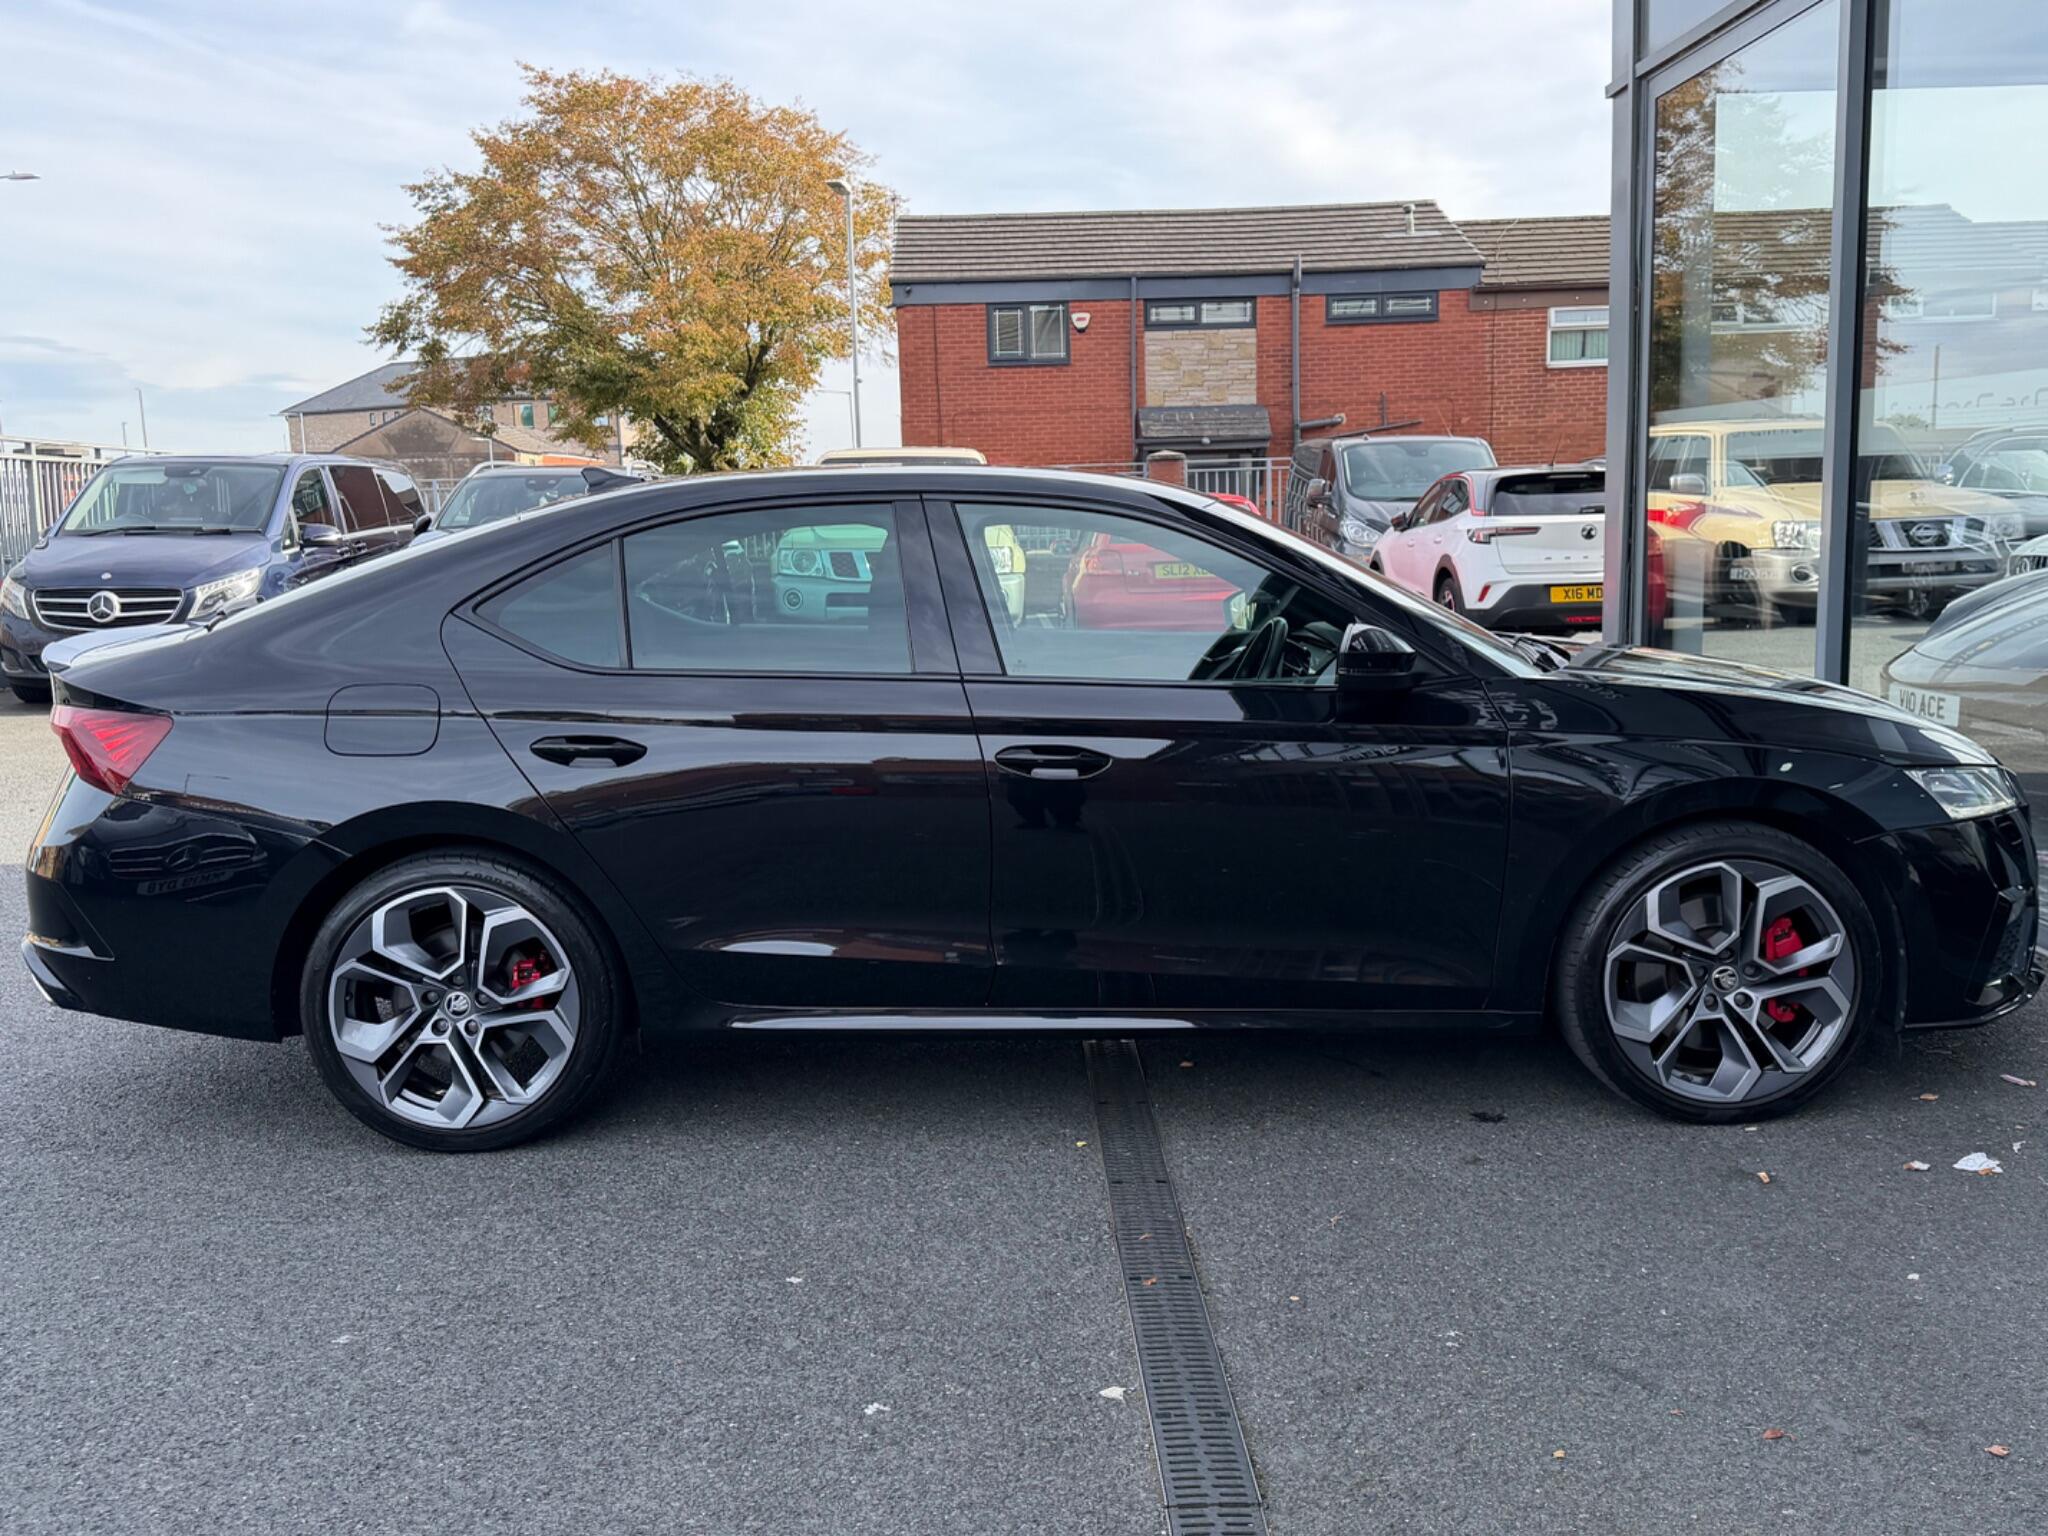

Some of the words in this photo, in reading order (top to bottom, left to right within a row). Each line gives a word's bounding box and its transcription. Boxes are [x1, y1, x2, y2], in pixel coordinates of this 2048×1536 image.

[1162, 564, 1190, 576] SL12
[1563, 588, 1583, 601] X16
[1899, 689, 1916, 713] V10
[1919, 693, 1946, 719] ACE
